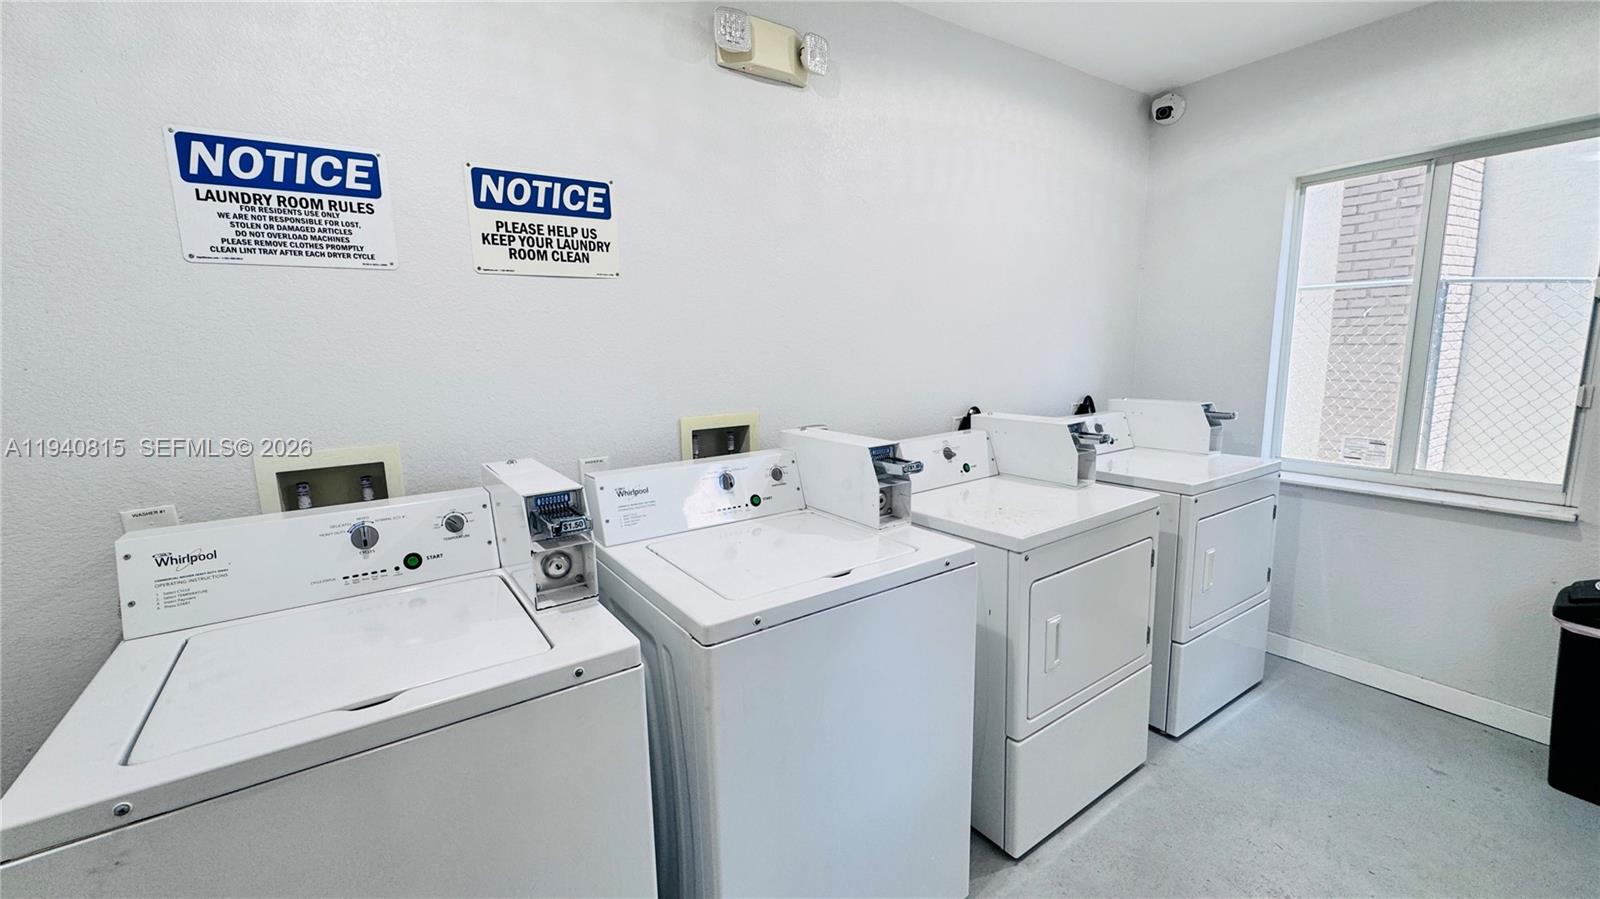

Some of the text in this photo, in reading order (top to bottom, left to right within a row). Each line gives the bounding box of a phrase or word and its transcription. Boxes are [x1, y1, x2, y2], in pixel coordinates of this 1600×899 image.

[188, 140, 374, 191] NOTICE
[195, 188, 375, 215] LAUNDRY ROOM RULES
[480, 174, 607, 214] NOTICE
[240, 205, 256, 213] FOR
[258, 206, 302, 216] RESIDENTS
[230, 221, 261, 230] STOLEN
[277, 225, 316, 233] DAMAGED
[317, 227, 352, 236] ARTICLES
[269, 216, 323, 226] RESPONSIBLE
[341, 221, 362, 229] LOST,
[495, 220, 597, 239] PLEASE HELP US
[221, 238, 364, 252] PLEASE REMOVE CLOTHES PROMPTLY
[267, 232, 308, 241] OVERLOAD
[310, 234, 350, 243] MACHINES
[481, 233, 611, 252] KEEP YOUR LAUNDRY
[210, 246, 237, 254] CLEAN
[258, 248, 278, 256] TRAY
[279, 249, 304, 257] AFTER
[305, 250, 325, 258] EACH
[509, 248, 590, 263] ROOM CLEAN
[616, 486, 649, 497] Whirlpool
[132, 510, 158, 518] WASHER
[563, 521, 584, 531] $1.50
[154, 549, 217, 567] Whirlpool
[154, 580, 187, 588] OPERATING
[189, 573, 229, 583] INSTRUCTIONS
